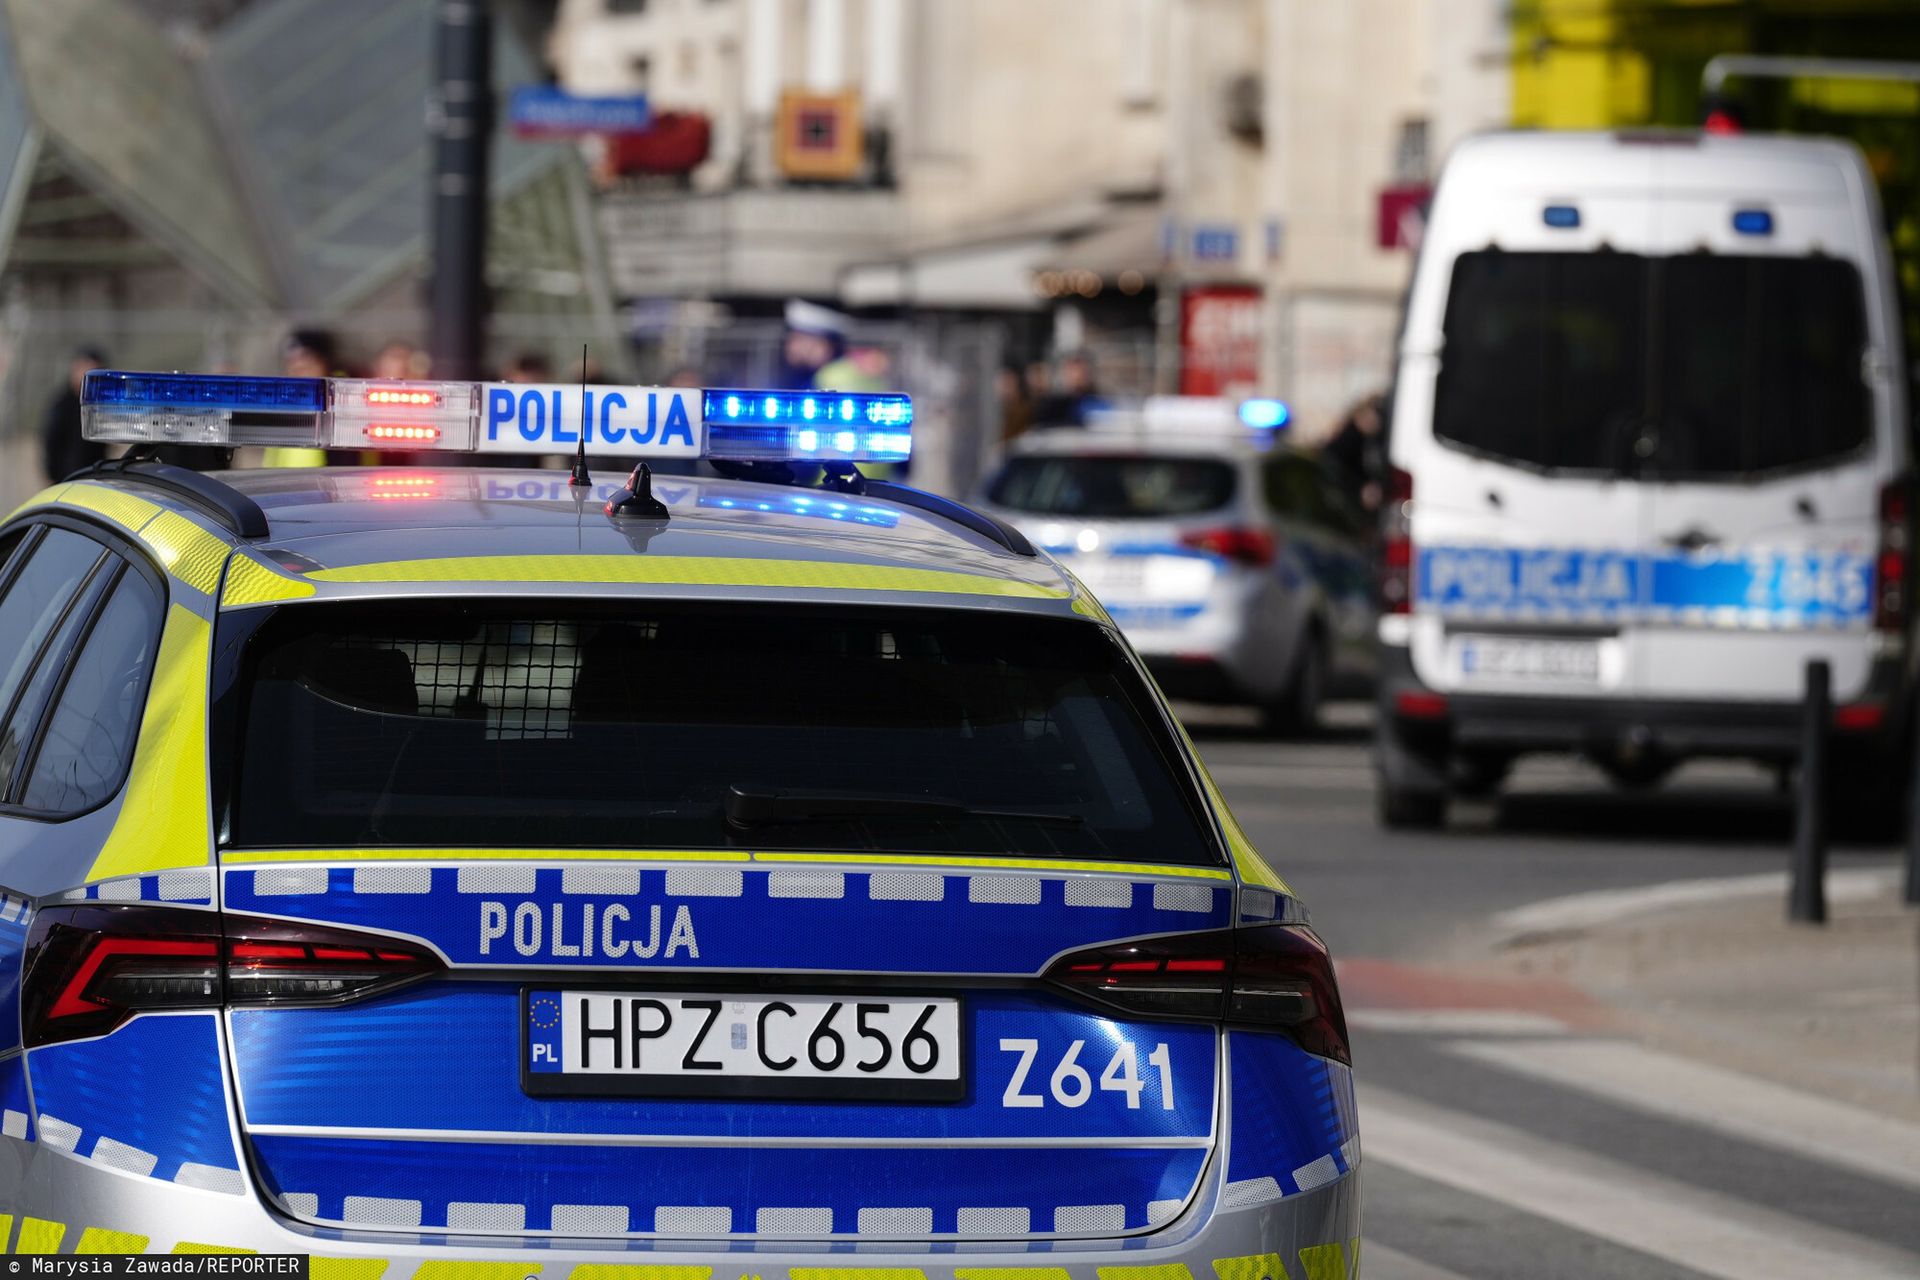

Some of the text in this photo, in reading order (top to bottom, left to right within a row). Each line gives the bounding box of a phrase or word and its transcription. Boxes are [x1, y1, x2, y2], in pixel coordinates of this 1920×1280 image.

[488, 388, 694, 446] POLICJA
[1430, 552, 1628, 604] POLICJA
[479, 901, 700, 958] POLICJA
[532, 1043, 558, 1062] PL
[580, 998, 939, 1074] HPZ C656
[1000, 1038, 1175, 1110] Z641
